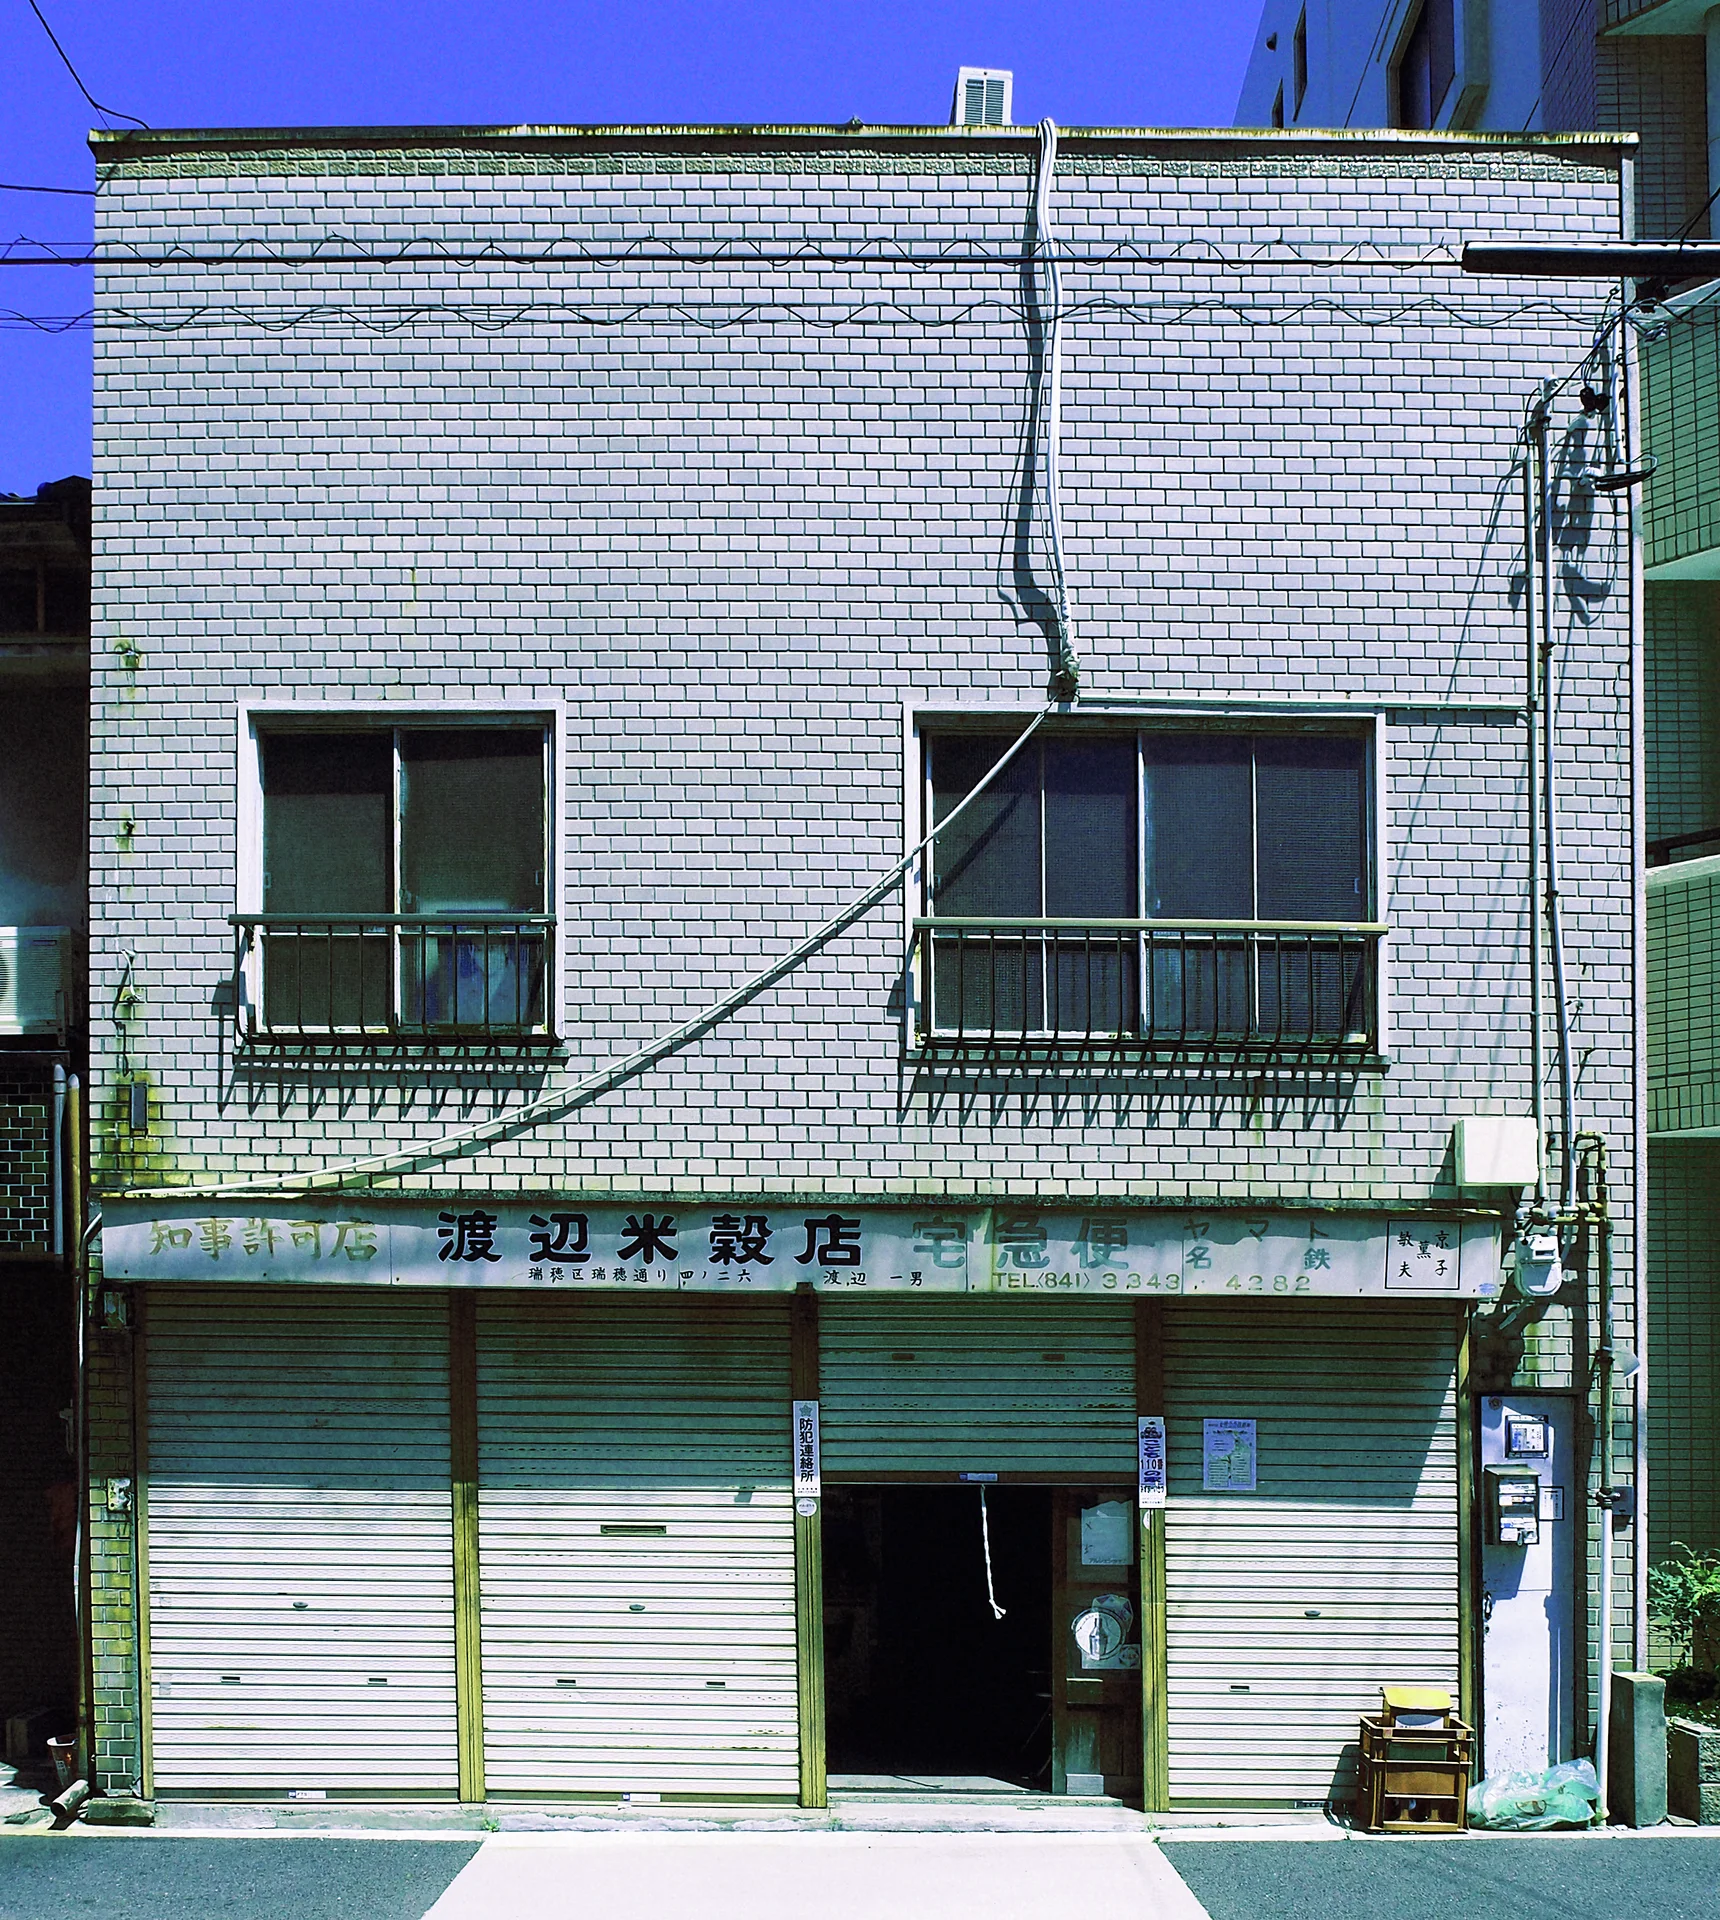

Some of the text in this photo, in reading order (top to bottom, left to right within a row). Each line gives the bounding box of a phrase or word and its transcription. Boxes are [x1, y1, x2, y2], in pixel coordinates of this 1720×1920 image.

[149, 1217, 378, 1261] 知事許可店
[436, 1210, 863, 1267] 渡辺米穀店
[912, 1214, 1130, 1271] 宅急便
[1184, 1218, 1329, 1242] ヤマト
[799, 1418, 815, 1482] 防犯連絡所
